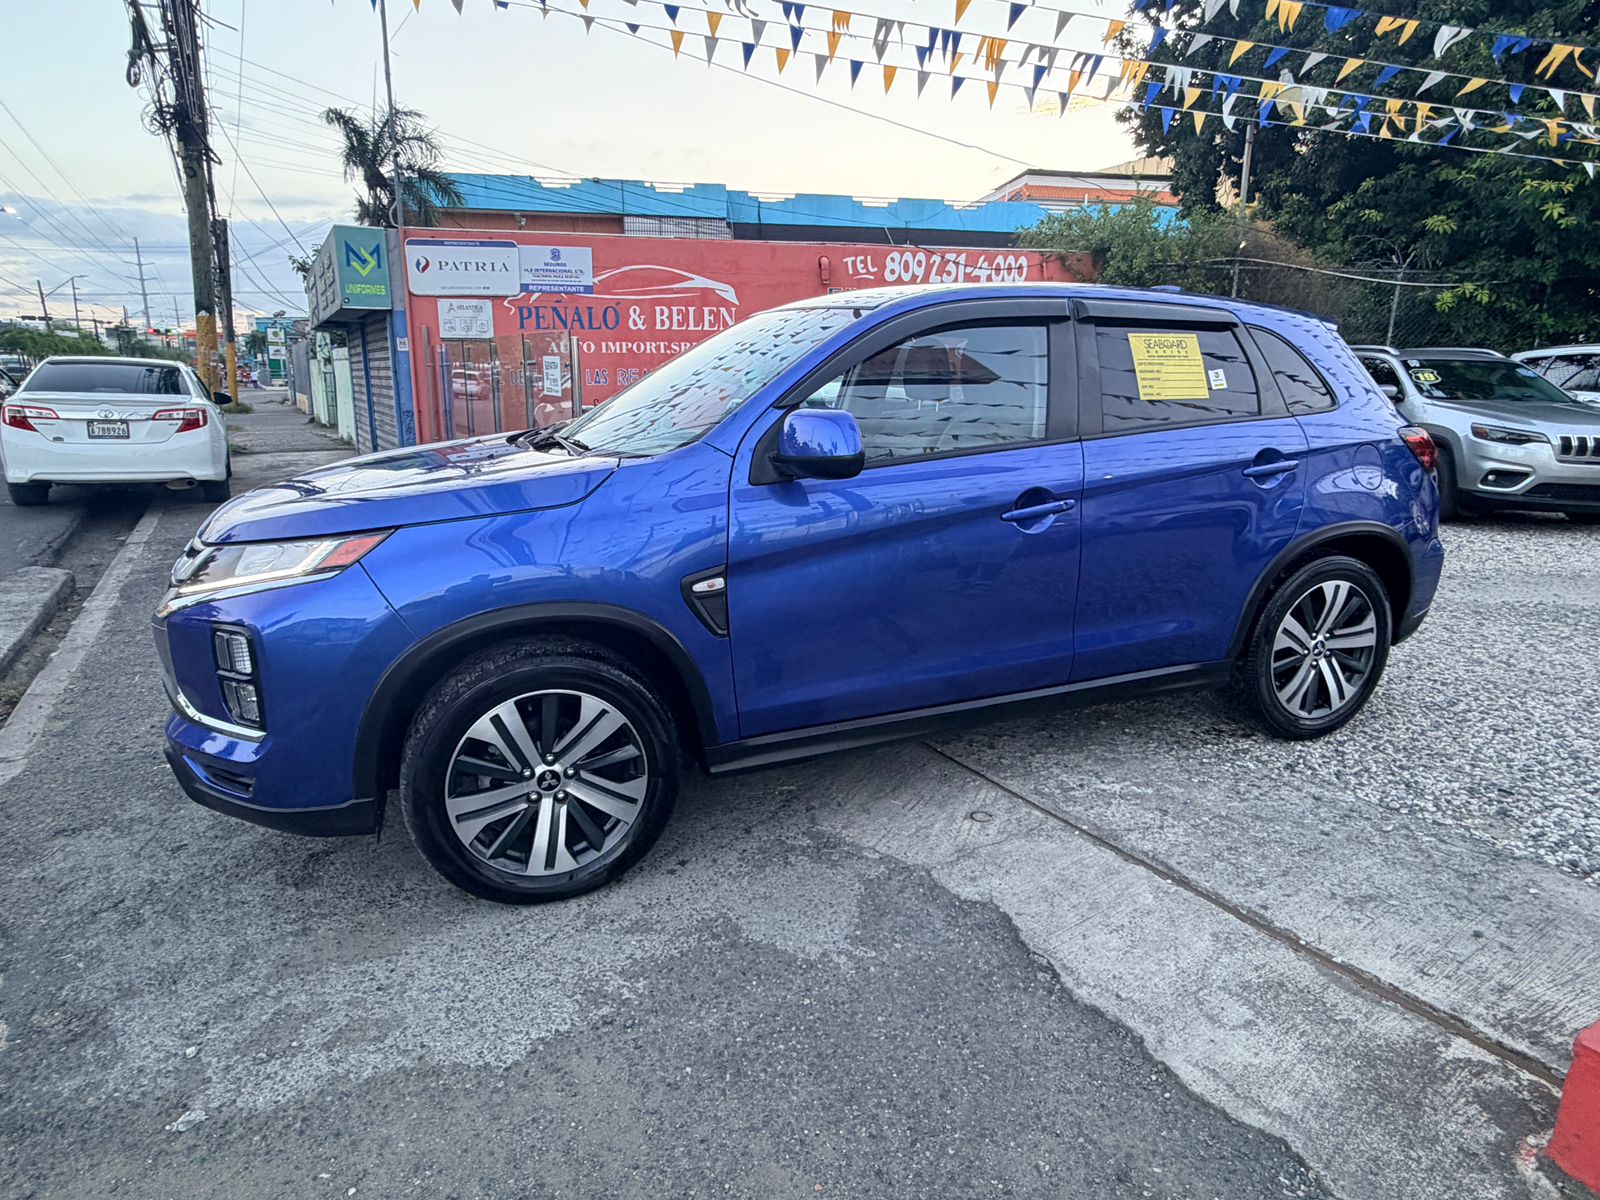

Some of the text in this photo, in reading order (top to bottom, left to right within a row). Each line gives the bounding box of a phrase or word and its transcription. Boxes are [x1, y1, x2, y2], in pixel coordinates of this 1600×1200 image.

[438, 260, 510, 273] PATRIA
[843, 251, 1028, 283] TEL 809 231-4000
[345, 283, 386, 296] UNIFORMES
[528, 284, 585, 293] REPRESENTANTE
[516, 299, 737, 331] PEÑALÓ & BELEN
[548, 340, 698, 355] AUO IMPORT,SR
[1143, 338, 1188, 350] SEABOARD
[585, 368, 609, 385] LAS
